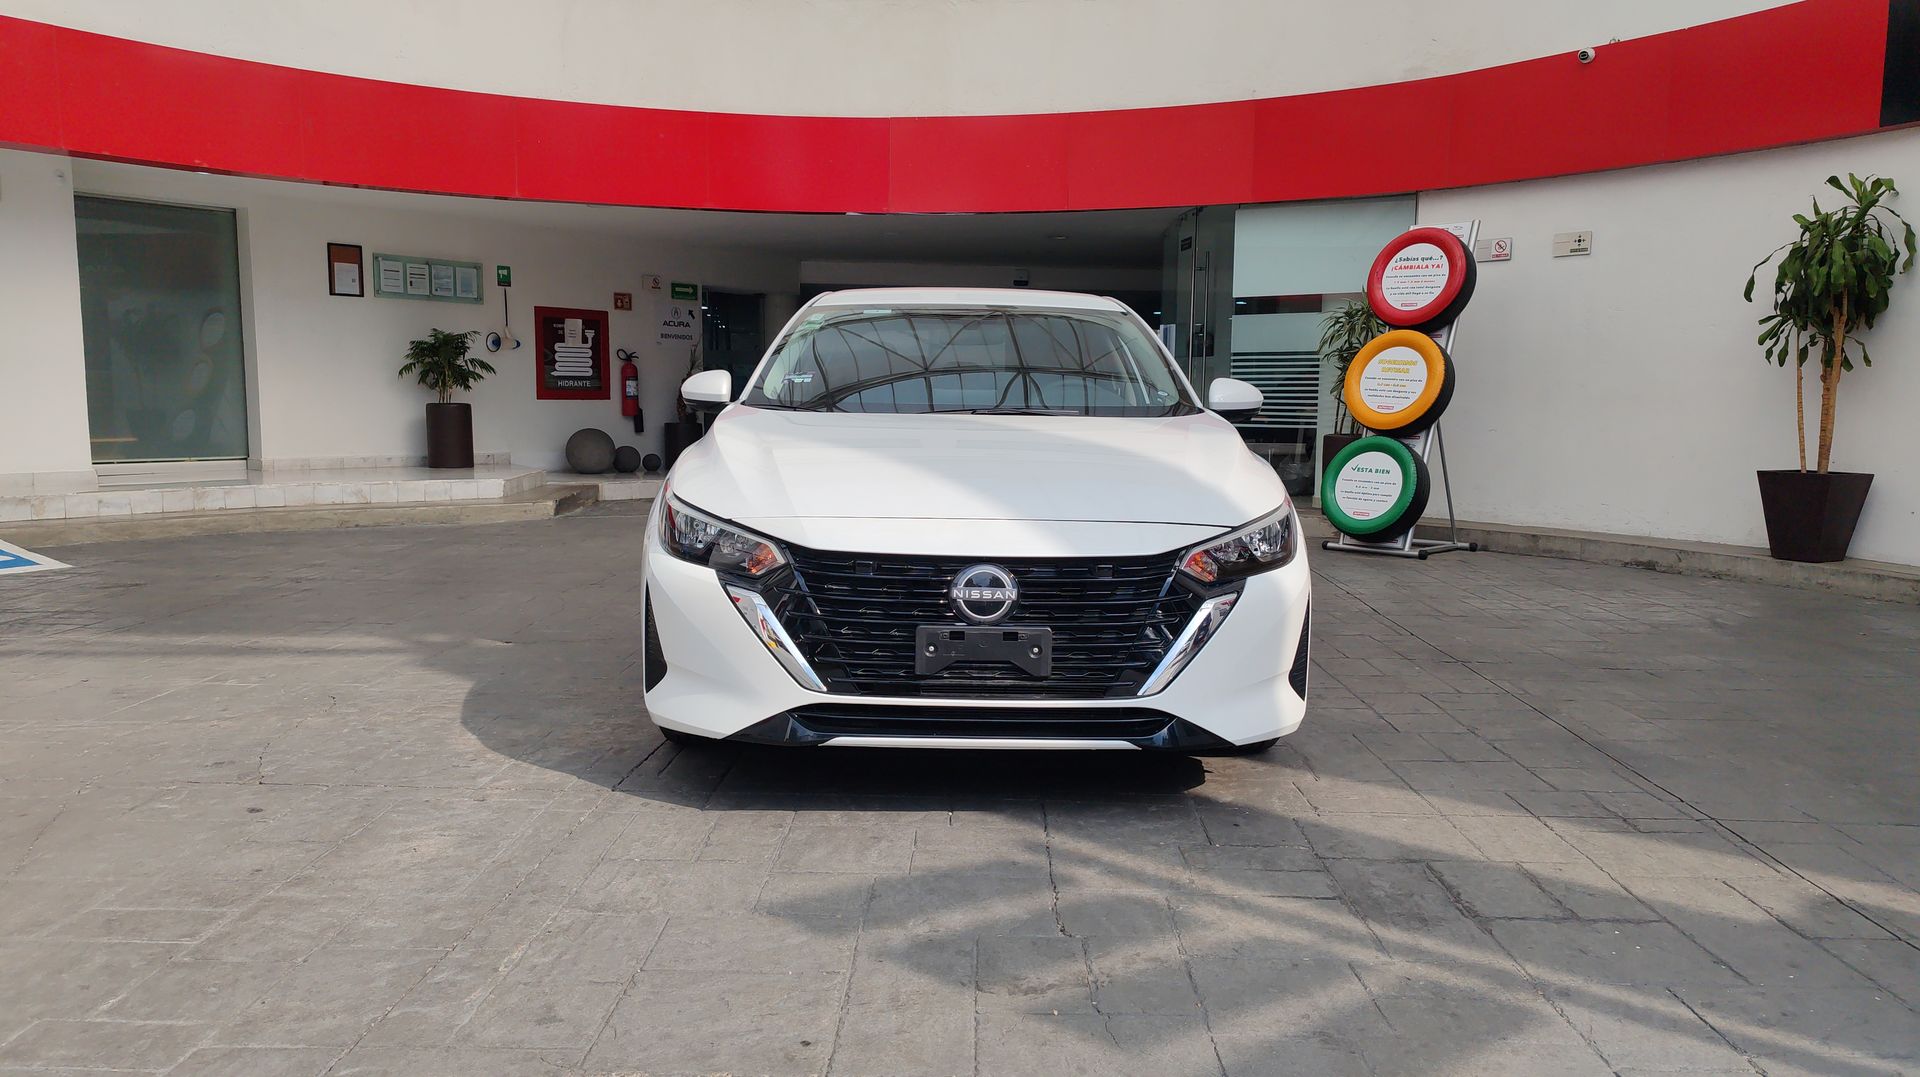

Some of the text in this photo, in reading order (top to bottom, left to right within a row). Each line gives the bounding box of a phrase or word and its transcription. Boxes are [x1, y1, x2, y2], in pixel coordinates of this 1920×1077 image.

[662, 320, 691, 328] ACURA
[1357, 466, 1374, 474] ESTA
[953, 589, 1017, 599] NISSAN
